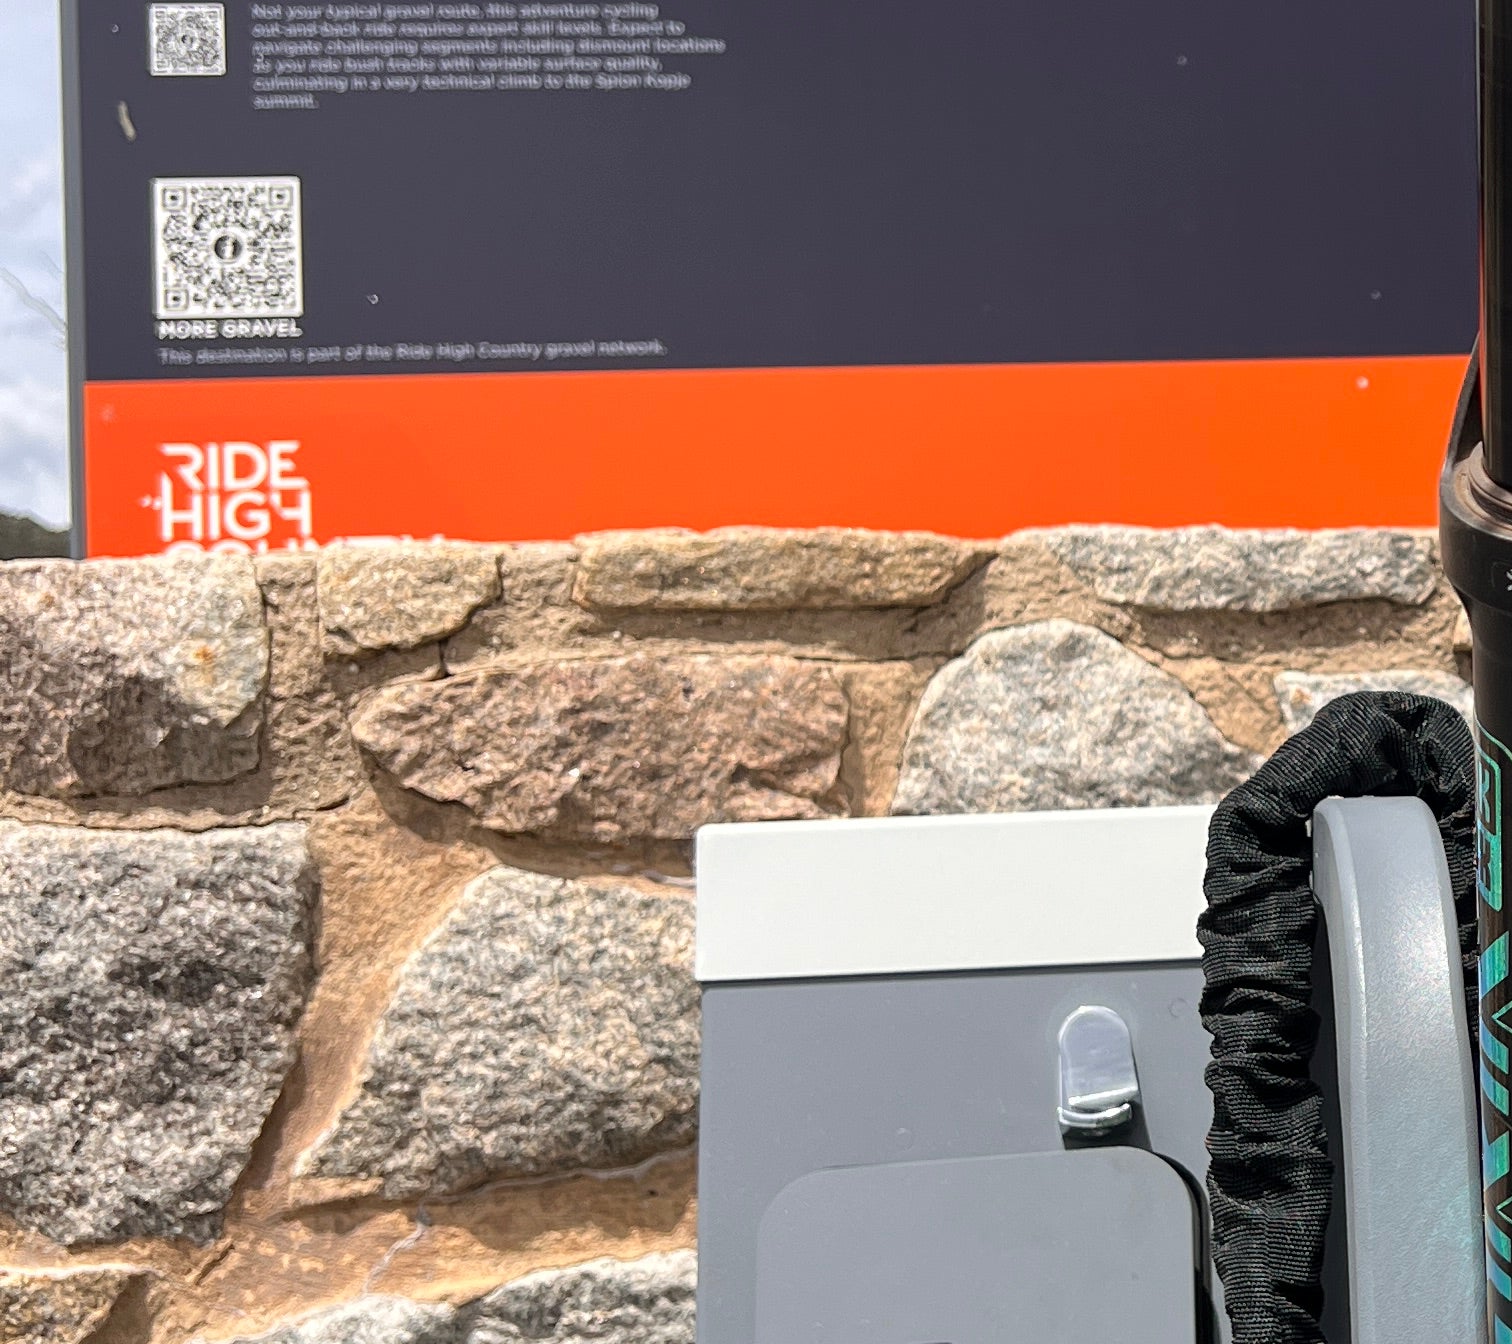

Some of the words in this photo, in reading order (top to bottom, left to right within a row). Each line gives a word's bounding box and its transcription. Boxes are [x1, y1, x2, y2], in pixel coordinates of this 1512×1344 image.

[158, 319, 218, 339] MORE
[220, 318, 303, 339] GRAVEL
[159, 440, 309, 491] RIDE
[160, 471, 312, 541] HIGH
